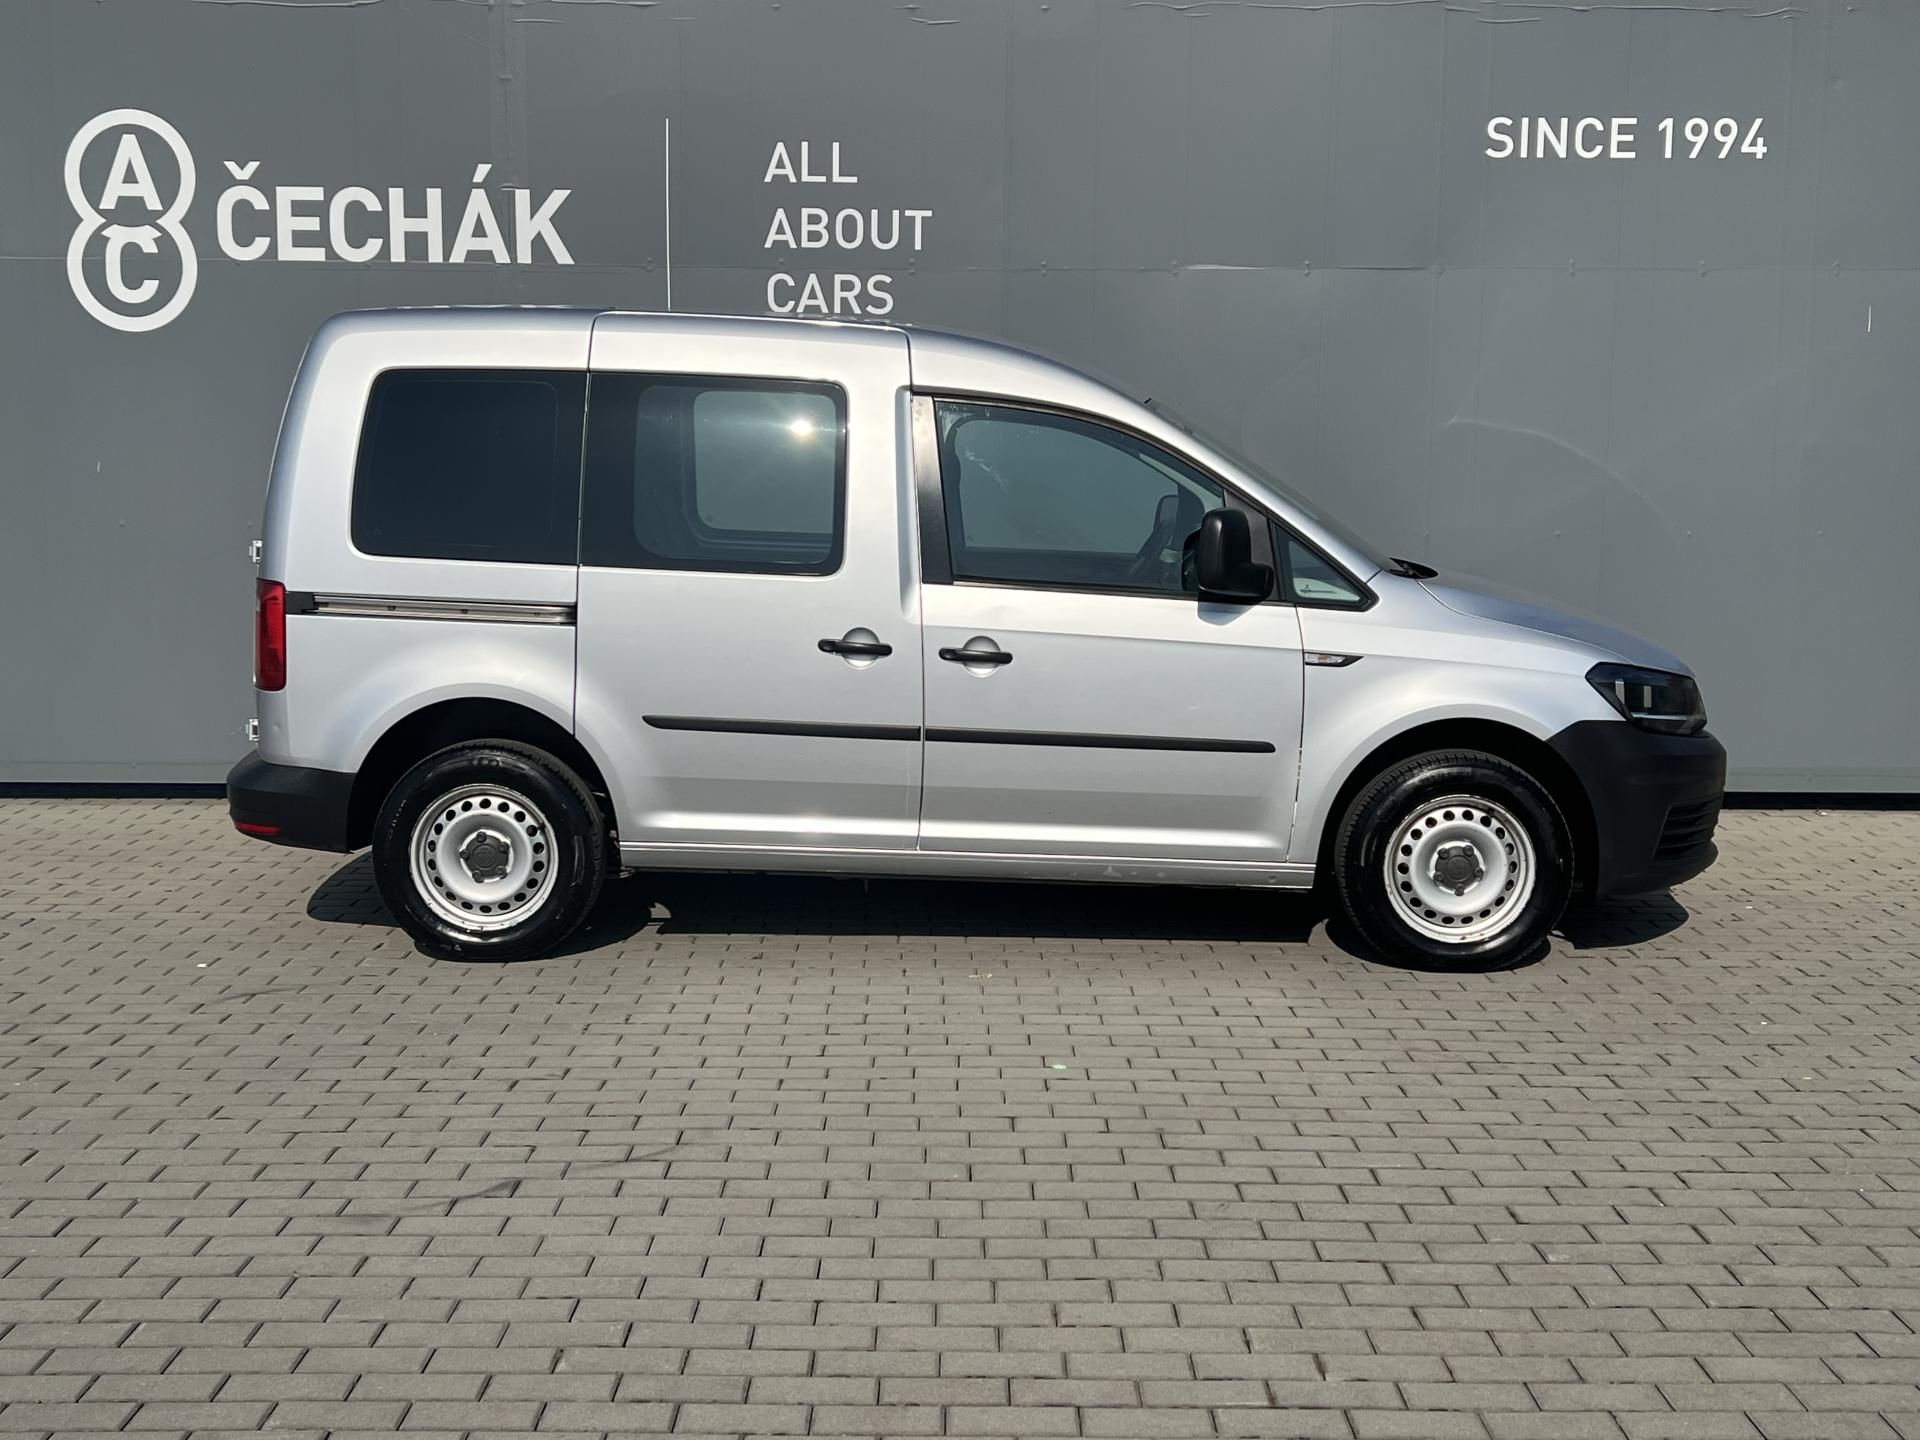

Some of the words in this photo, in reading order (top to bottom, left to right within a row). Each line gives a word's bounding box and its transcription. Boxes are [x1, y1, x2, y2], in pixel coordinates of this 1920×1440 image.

[1484, 116, 1638, 159] SINCE
[1658, 116, 1768, 159] 1994
[99, 133, 164, 210] A
[763, 141, 858, 183] ALL
[216, 160, 575, 265] ČECHÁK
[763, 207, 933, 251] ABOUT
[766, 271, 895, 315] CARS
